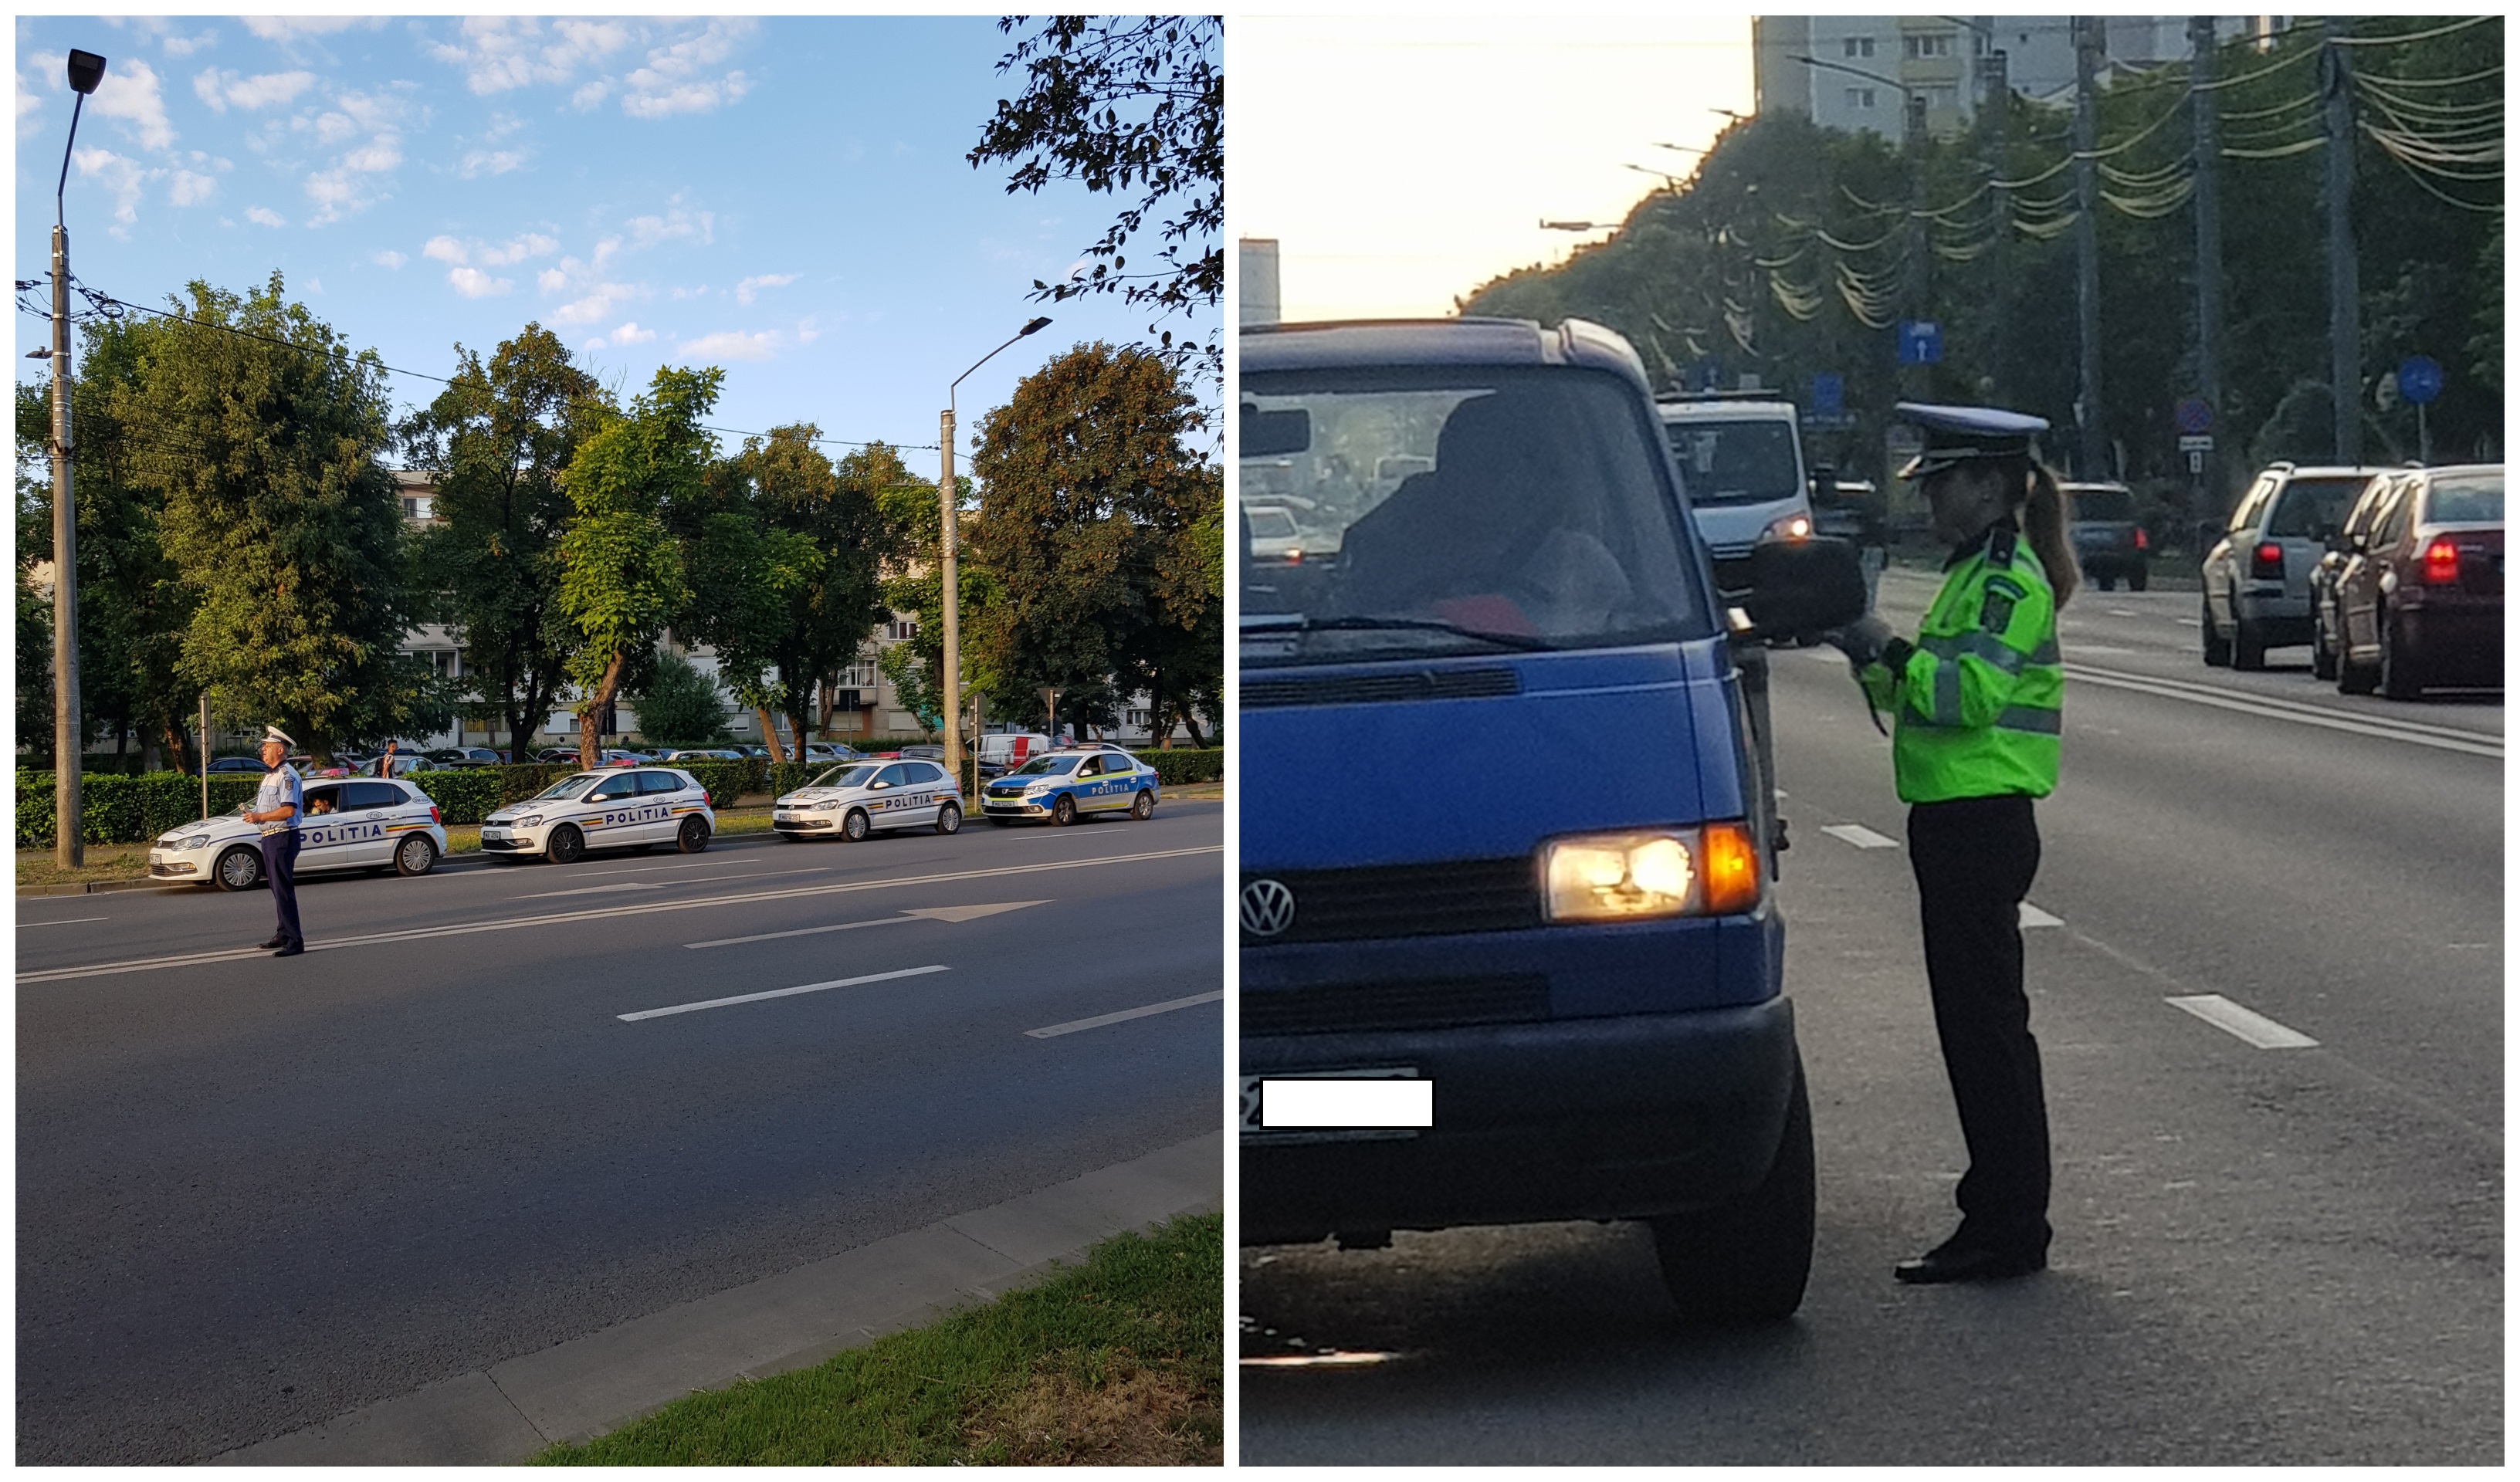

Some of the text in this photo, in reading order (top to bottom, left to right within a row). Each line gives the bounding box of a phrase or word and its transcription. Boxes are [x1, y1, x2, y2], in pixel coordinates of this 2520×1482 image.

[1092, 784, 1129, 795] POLITIA
[886, 795, 930, 809] POLITIA
[606, 807, 668, 824] POLITIA
